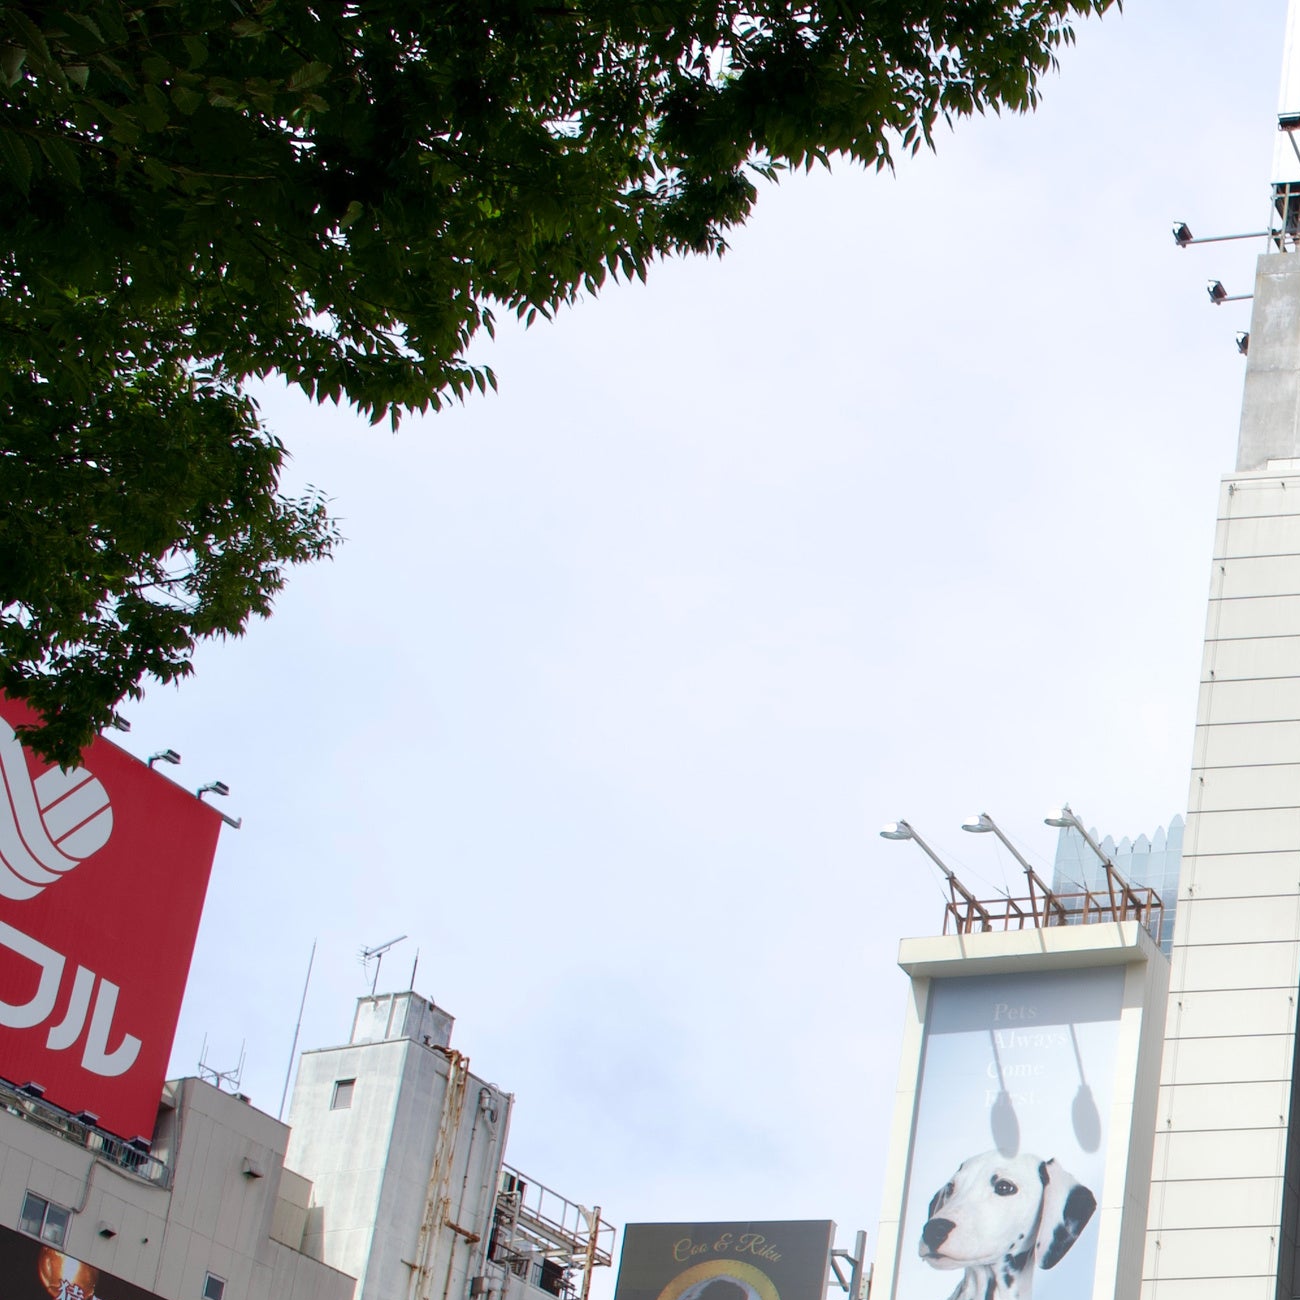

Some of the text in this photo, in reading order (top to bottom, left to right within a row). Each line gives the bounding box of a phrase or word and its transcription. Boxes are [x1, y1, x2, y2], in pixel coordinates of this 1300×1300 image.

[673, 1232, 784, 1263] Coo & Riku
